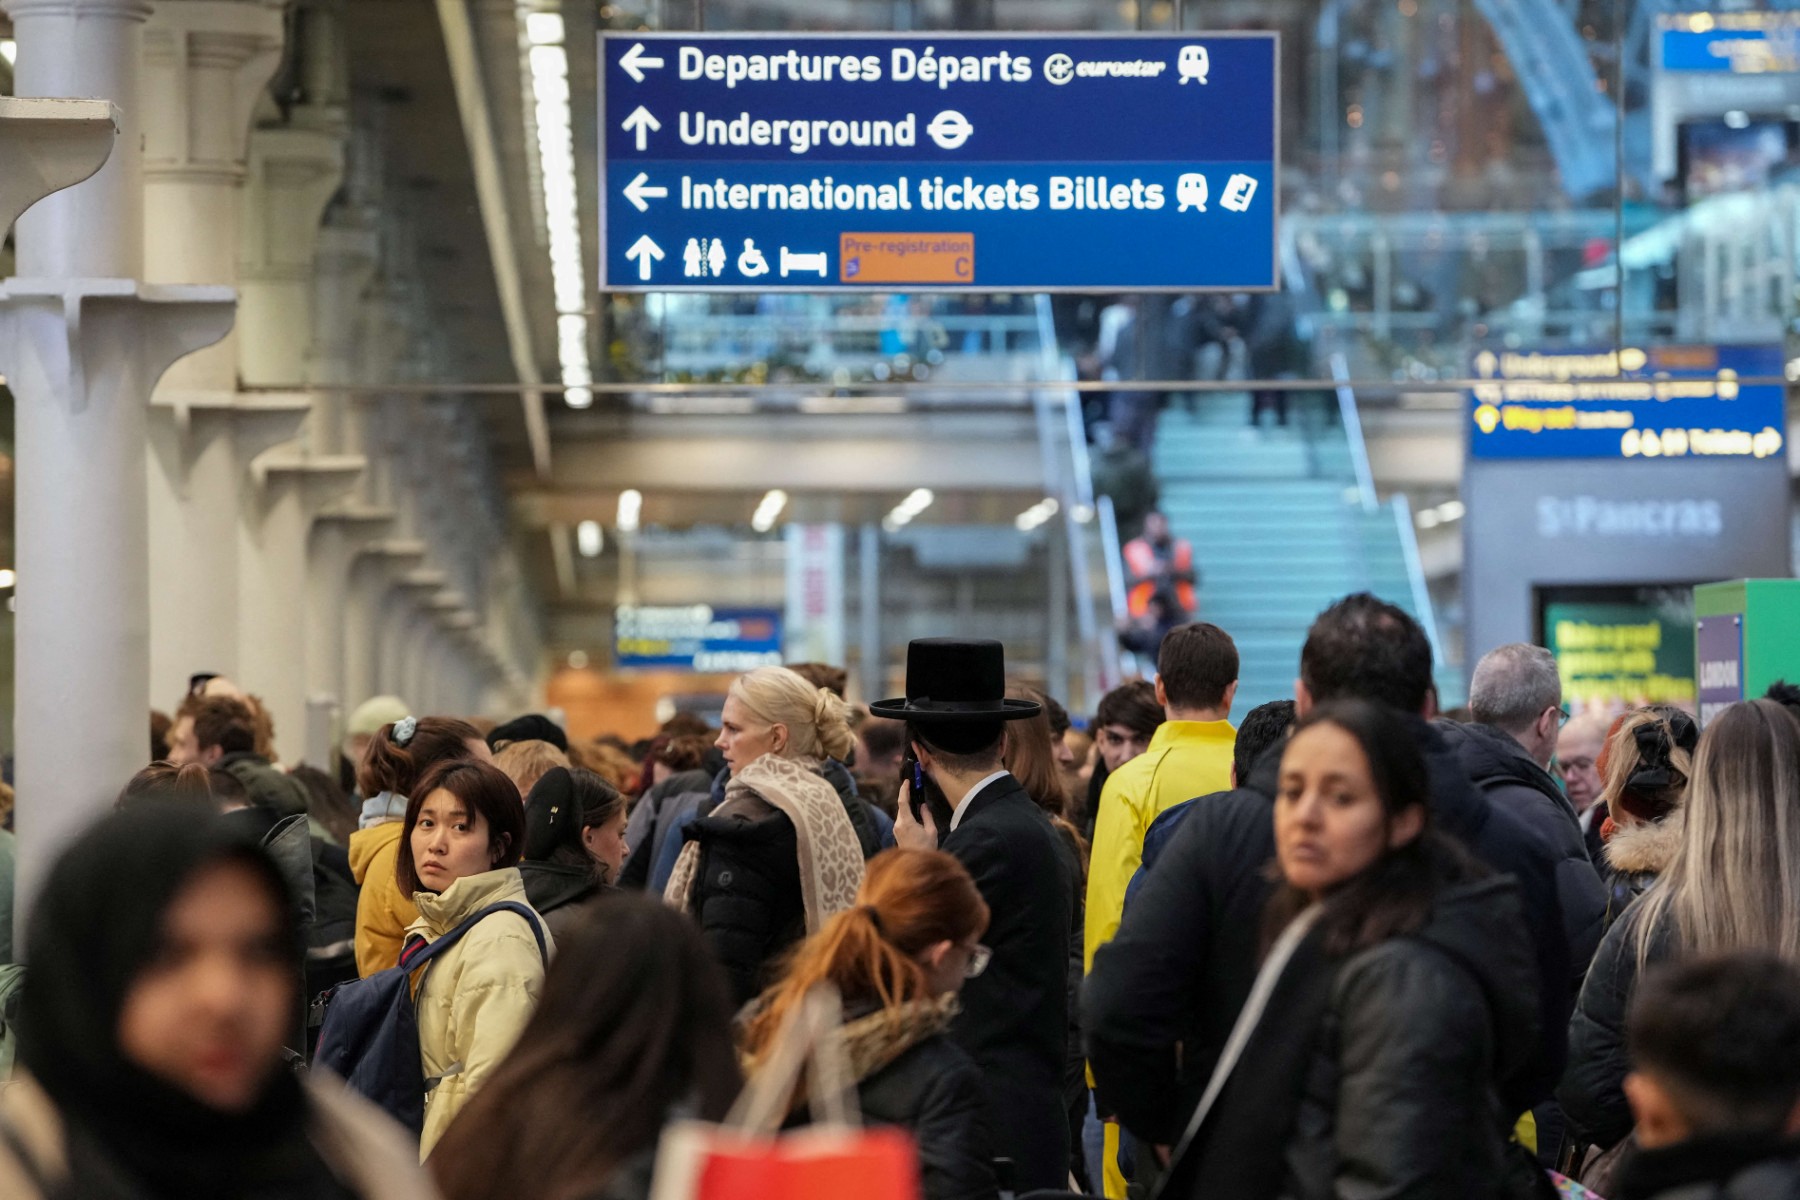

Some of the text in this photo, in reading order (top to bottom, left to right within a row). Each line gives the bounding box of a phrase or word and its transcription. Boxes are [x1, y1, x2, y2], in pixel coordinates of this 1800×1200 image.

[679, 46, 1167, 90] Departures Départs eurostar
[679, 111, 916, 154] Underground
[681, 176, 1165, 211] International tickets Billets
[844, 238, 970, 256] Pre-registration
[955, 256, 970, 277] C
